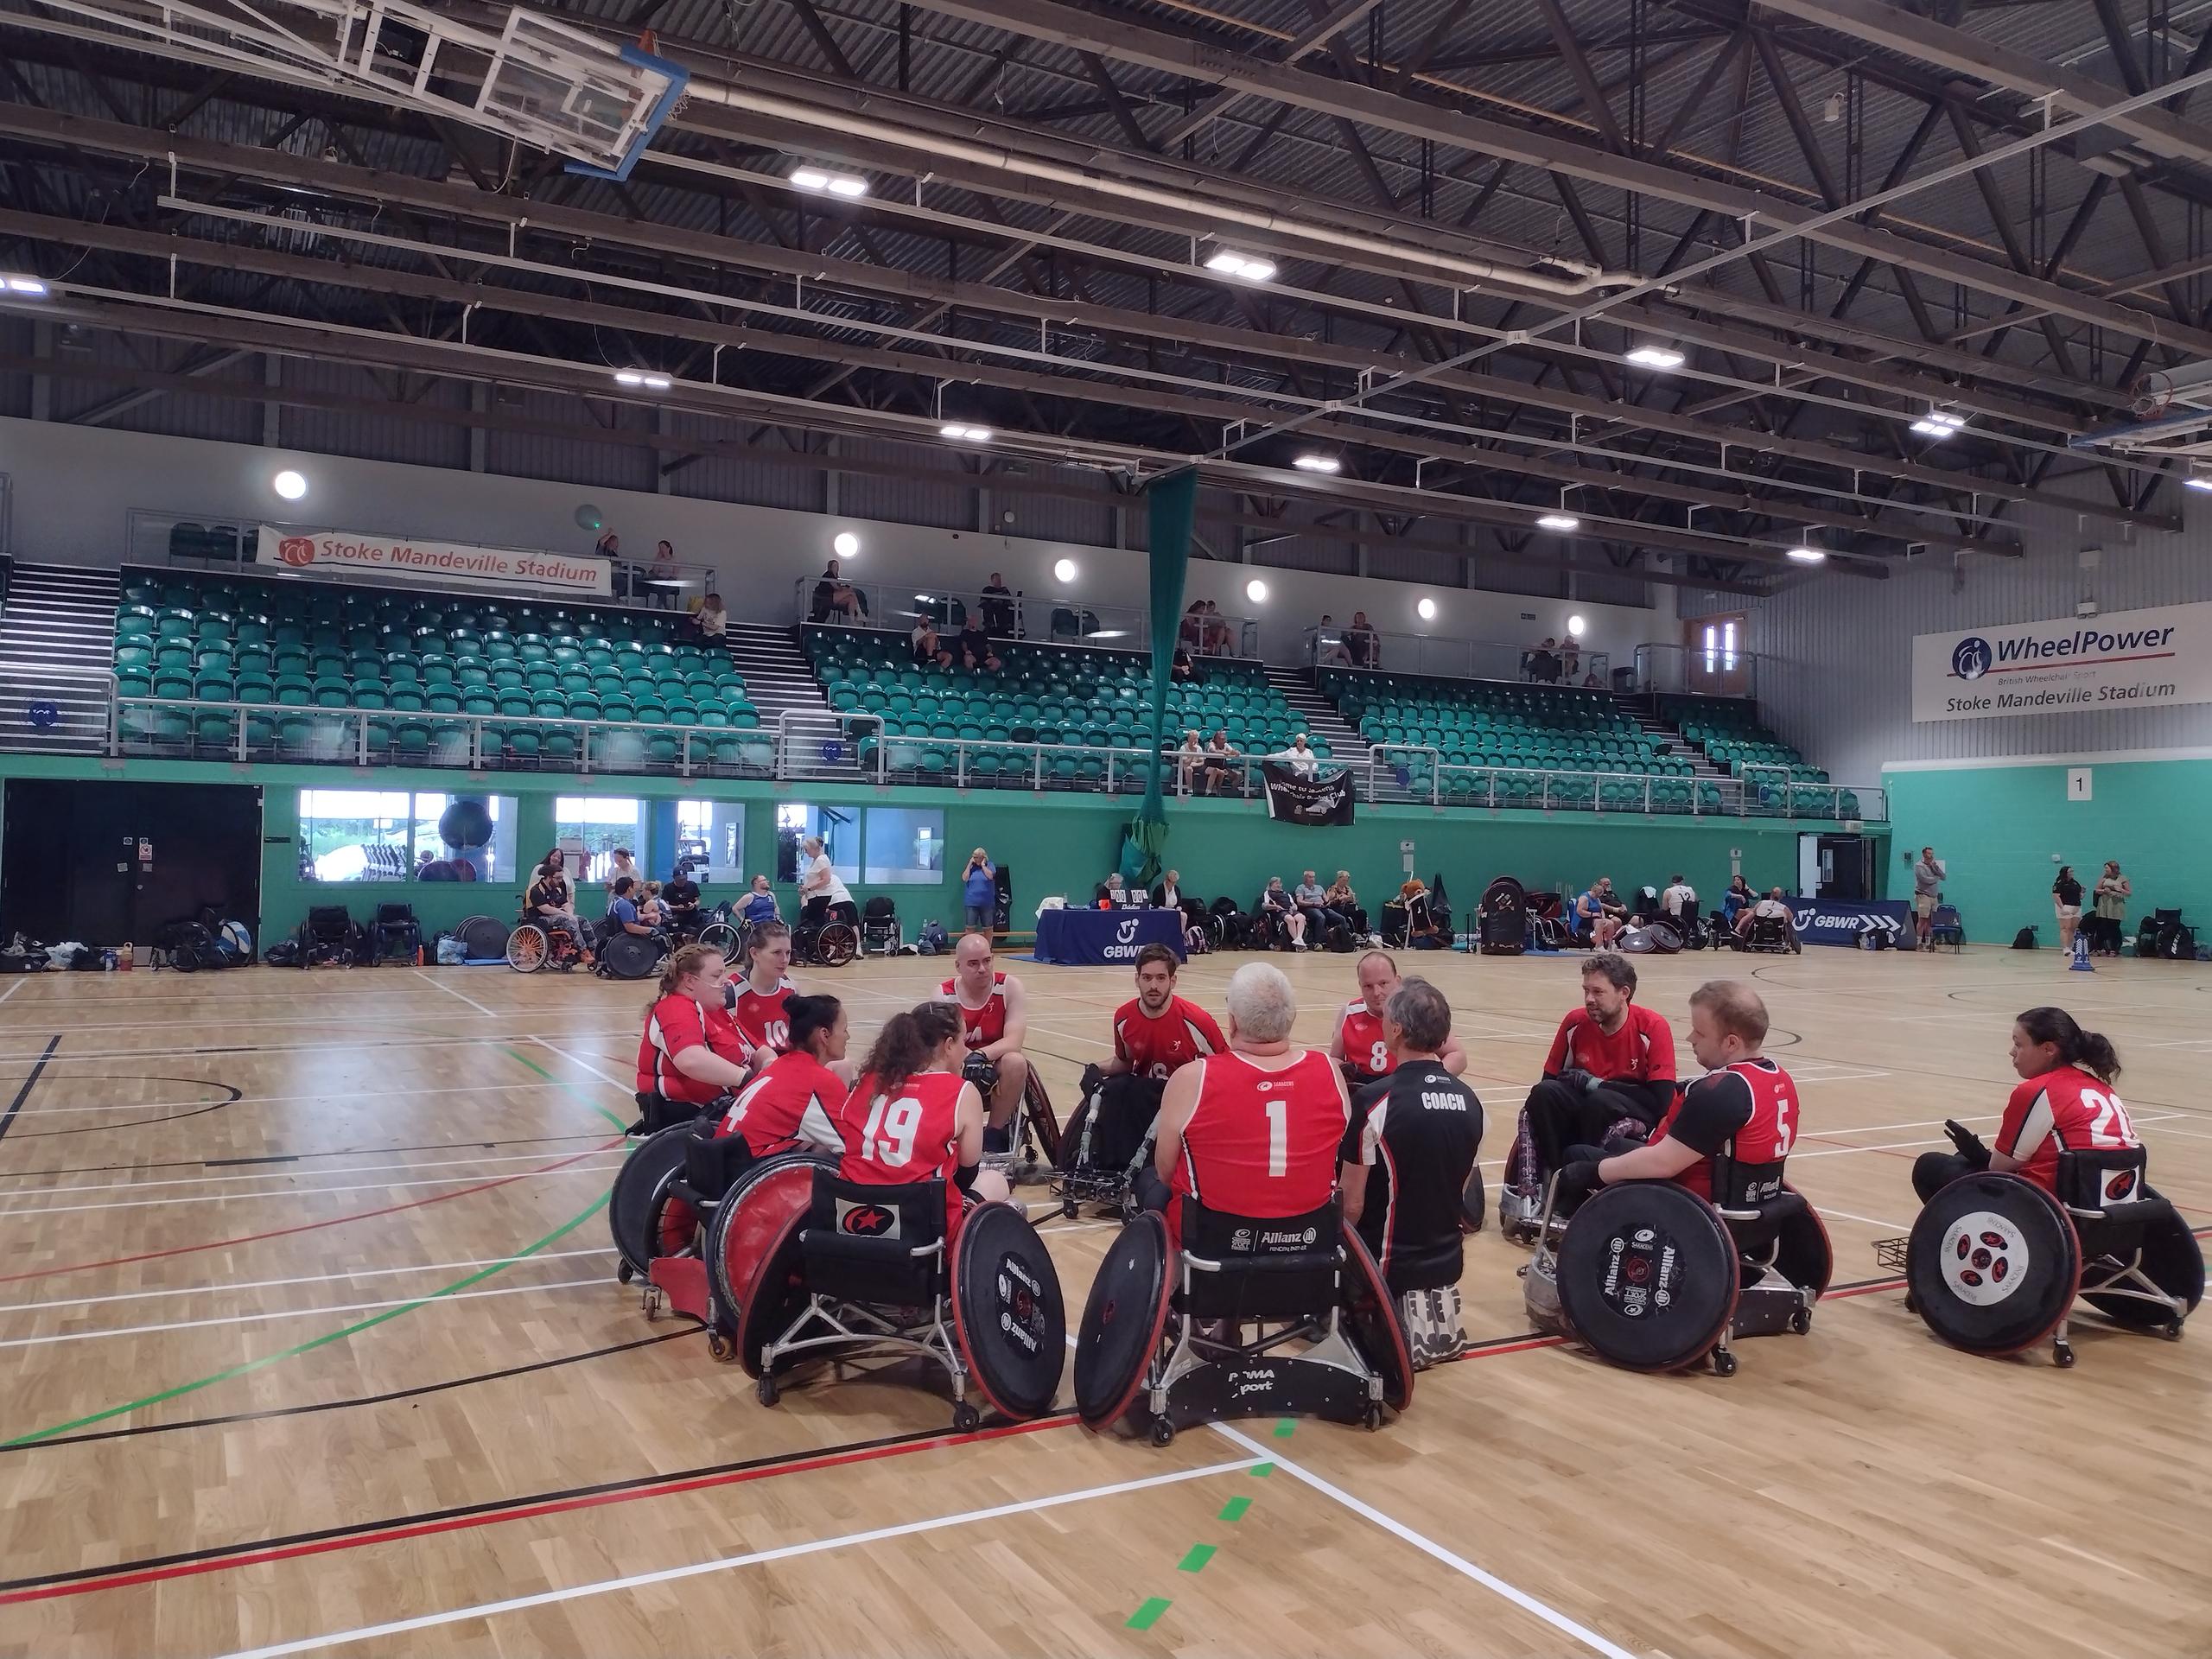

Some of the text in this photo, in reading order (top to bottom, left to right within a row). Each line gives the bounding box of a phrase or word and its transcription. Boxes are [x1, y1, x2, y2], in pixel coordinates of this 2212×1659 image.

[321, 541, 598, 582] Stoke Mandeville Stadium
[1998, 626, 2175, 662] WheelPower
[1998, 677, 2023, 685] British
[2024, 672, 2069, 683] Wheelchai
[1947, 683, 2176, 712] Stoke Mandeville Stadium
[1330, 790, 1346, 799] Club
[2075, 778, 2082, 791] 1
[1815, 915, 1859, 929] GBWR
[765, 1020, 789, 1047] 10
[1370, 1040, 1388, 1071] 8
[1421, 1092, 1466, 1111] COACH
[861, 1094, 923, 1168] 19
[1774, 1098, 1791, 1158] 5
[2080, 1088, 2140, 1148] 20
[1265, 1100, 1287, 1177] 1
[1261, 1231, 1302, 1244] Allianz
[1006, 1258, 1032, 1287] Allianz
[1605, 1255, 1621, 1296] Allianz
[1659, 1245, 1675, 1288] Allianz
[1011, 1322, 1038, 1352] Allianz
